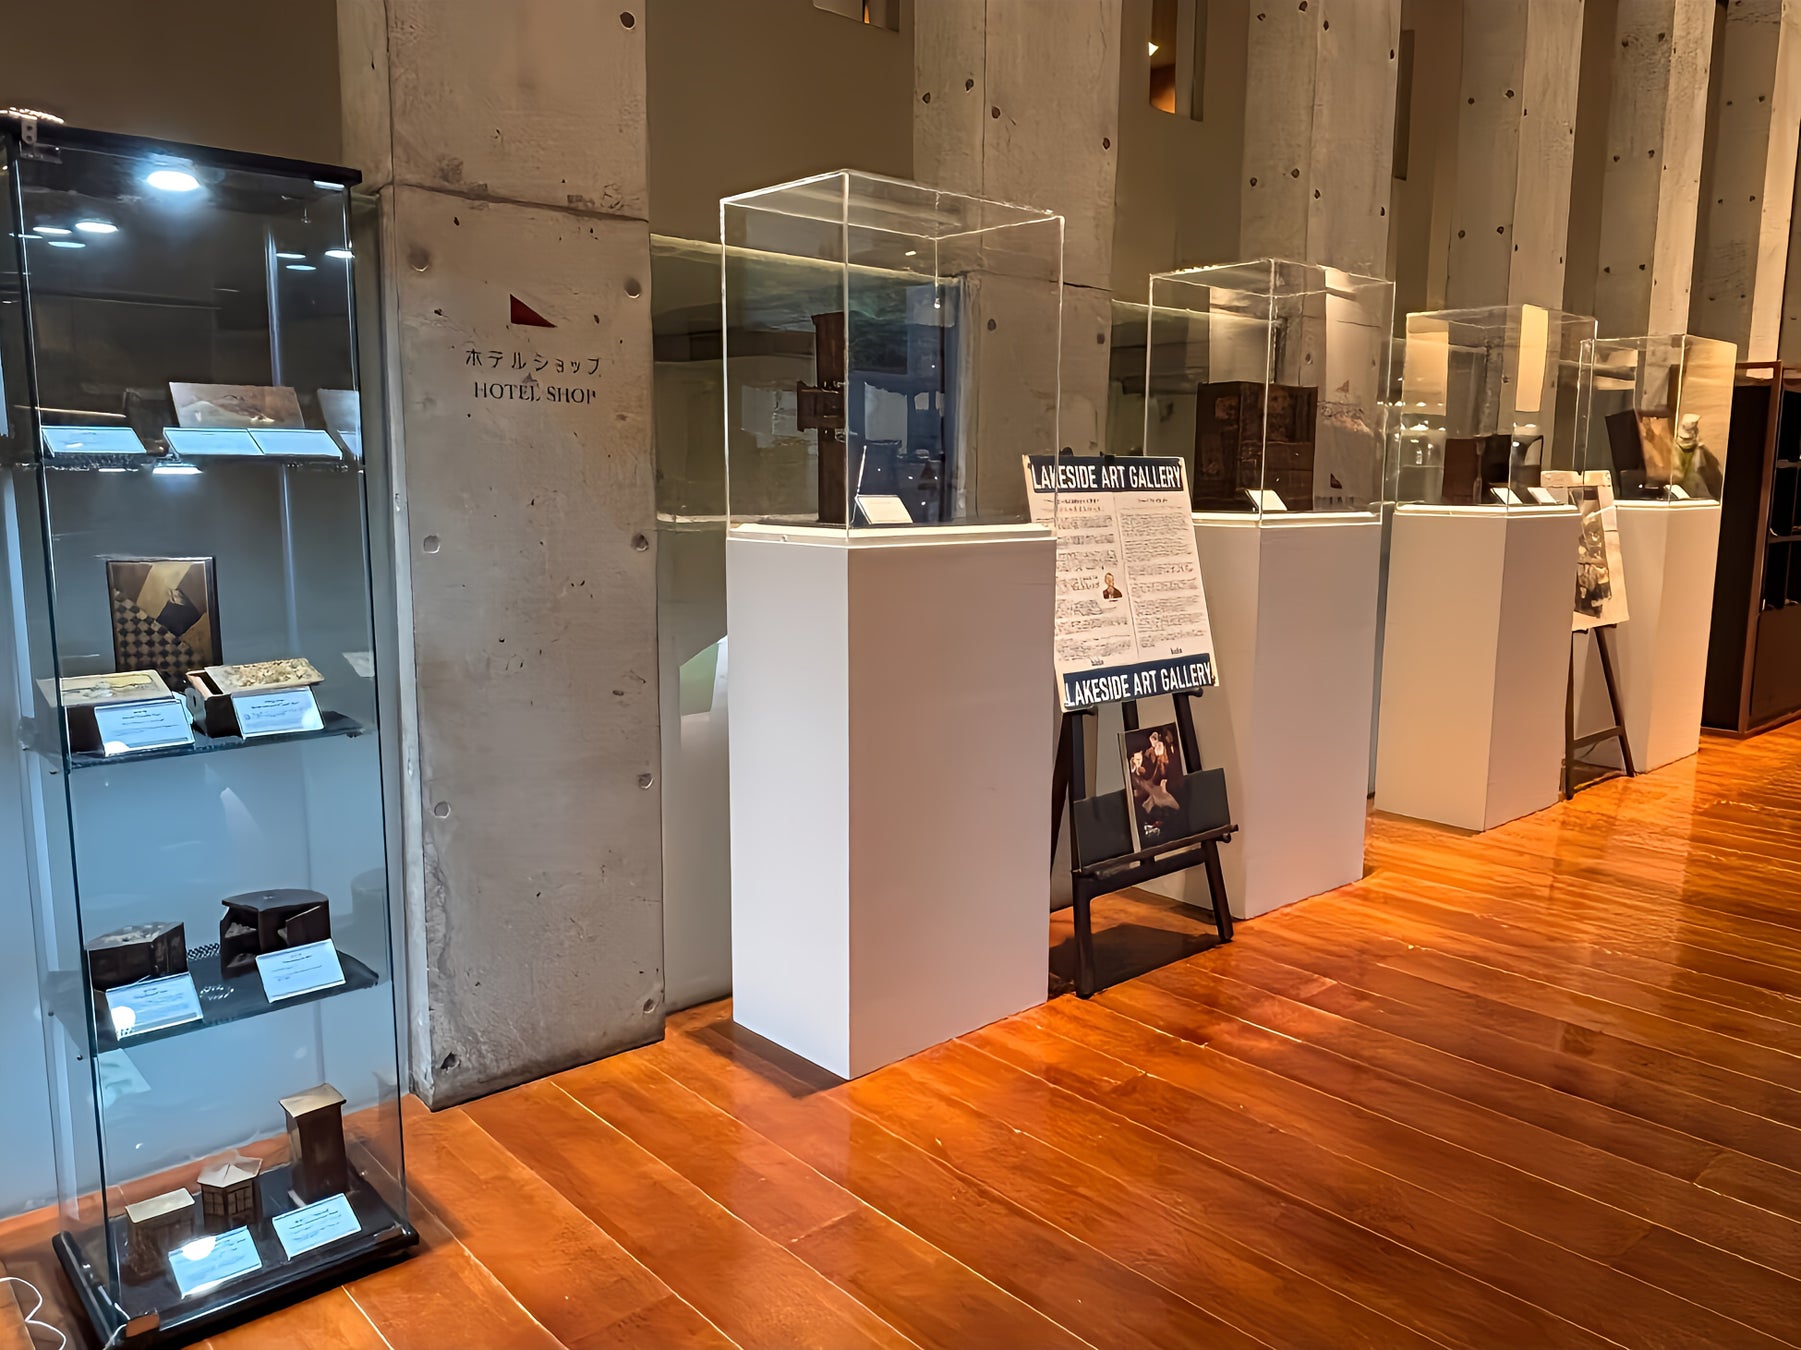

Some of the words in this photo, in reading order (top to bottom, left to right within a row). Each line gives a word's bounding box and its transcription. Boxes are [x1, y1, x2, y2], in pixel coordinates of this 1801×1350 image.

[466, 348, 600, 375] ホテルショップ
[474, 381, 540, 402] HOTEL
[547, 385, 597, 404] SHOP
[1031, 464, 1099, 490] LAKESIDE
[1102, 465, 1126, 489] ART
[1129, 464, 1182, 489] GALLERY
[1064, 674, 1131, 707] LAKESIDE
[1133, 670, 1158, 696] ART
[1160, 661, 1213, 691] GALLERY
